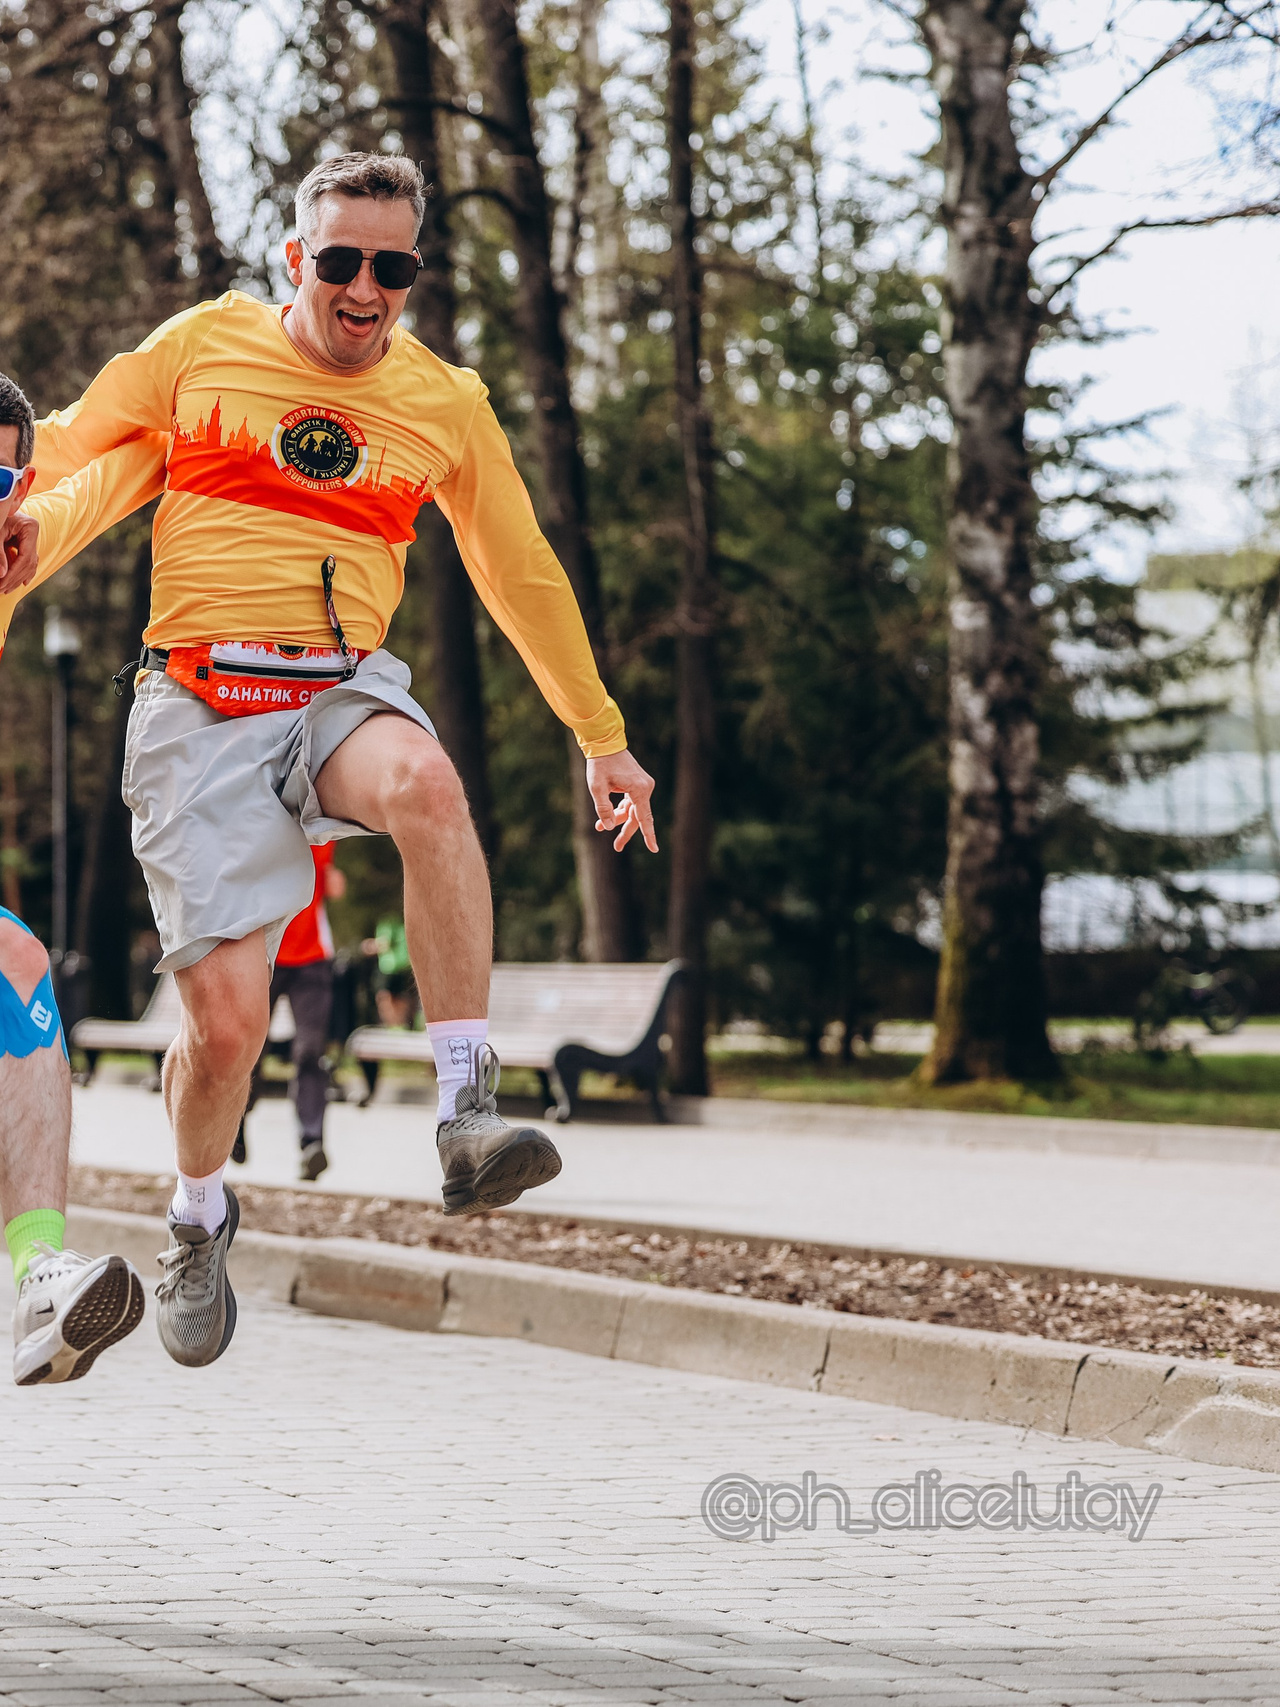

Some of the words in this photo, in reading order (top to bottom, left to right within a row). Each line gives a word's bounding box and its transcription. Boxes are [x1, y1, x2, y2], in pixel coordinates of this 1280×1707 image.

[284, 408, 326, 427] SPARTAK
[329, 412, 364, 444] MOSCOW
[288, 448, 310, 474] SQUAD
[286, 468, 342, 490] SUPPORTERS
[217, 685, 293, 703] ФАНАТИК
